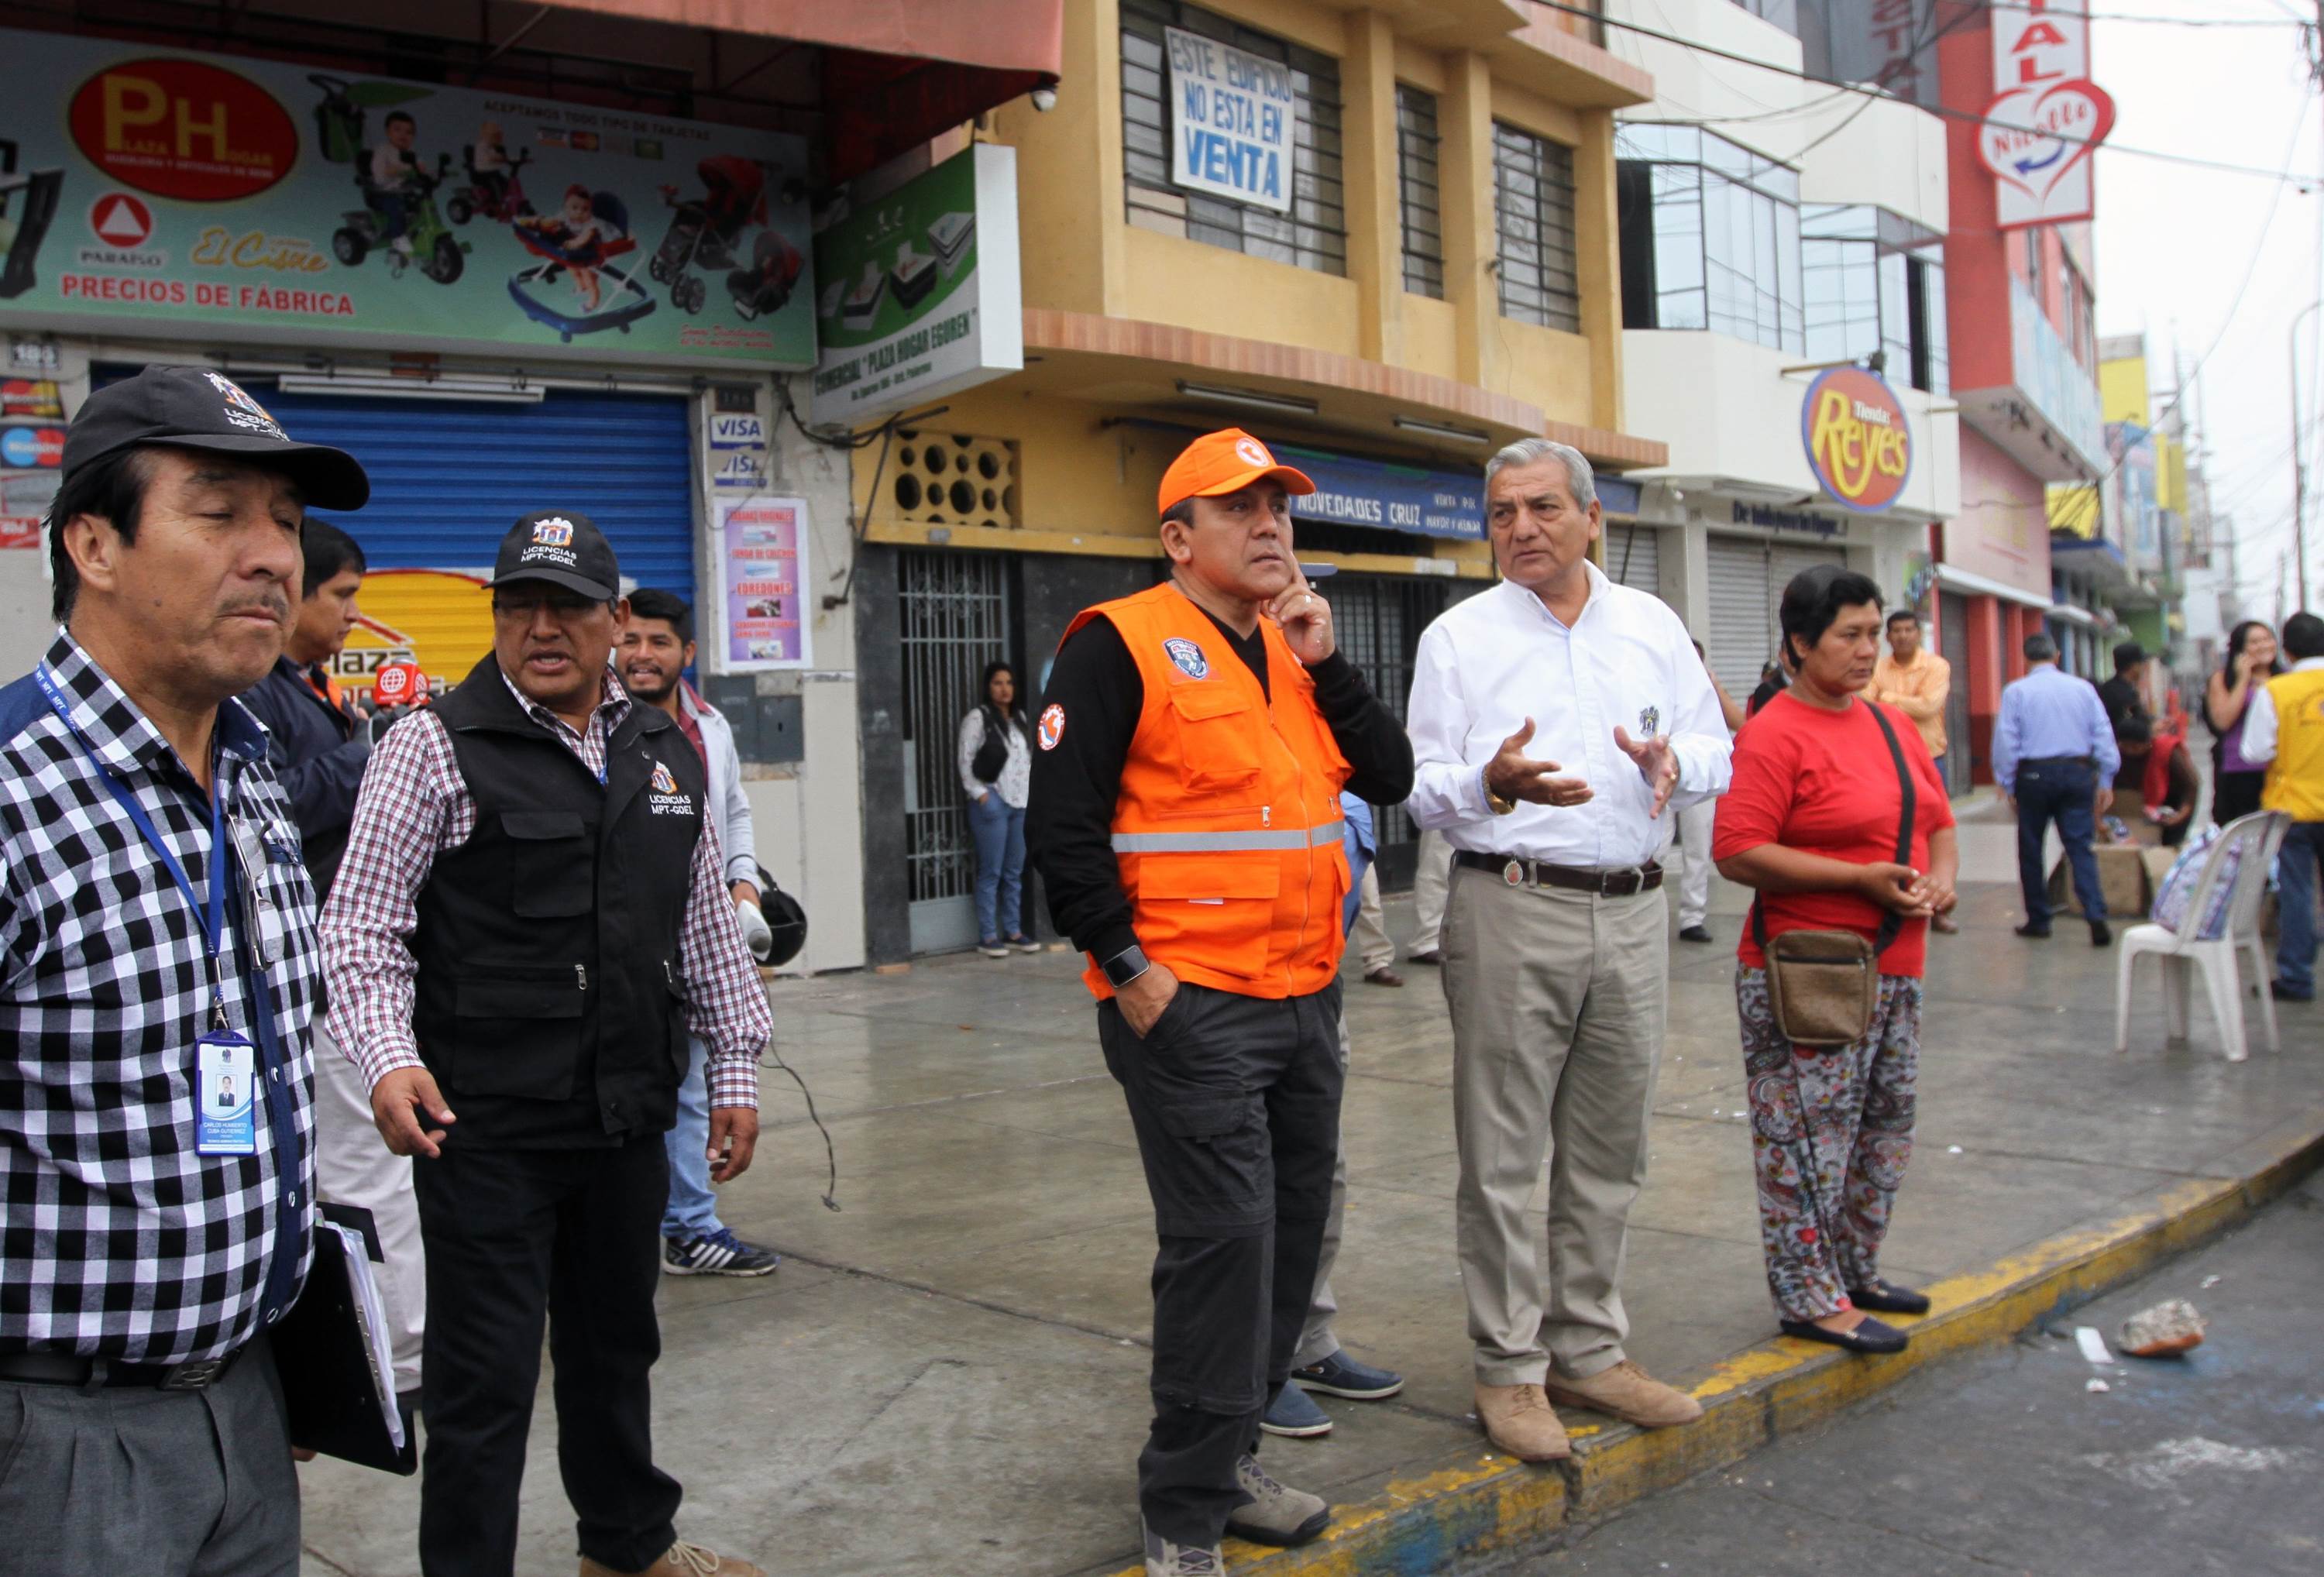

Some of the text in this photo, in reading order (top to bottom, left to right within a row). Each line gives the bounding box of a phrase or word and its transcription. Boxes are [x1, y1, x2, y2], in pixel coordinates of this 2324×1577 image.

[1169, 33, 1291, 102] ESTE EDIFICIO
[1184, 80, 1282, 145] NO ESTA EN
[1993, 101, 2087, 159] Nicolle
[1184, 125, 1281, 198] VENTA
[192, 226, 328, 273] El Cisne
[61, 275, 353, 315] PRECIOS DE FÁBRICA
[717, 419, 761, 435] VISA
[1854, 400, 1891, 425] Tiendas
[1812, 389, 1908, 499] Reyes
[1298, 492, 1421, 526] NOVEDADES CRUZ
[1425, 515, 1481, 533] MAYOR Y MENOR
[521, 552, 576, 567] MPT-GDEL
[523, 545, 577, 560] LICENCIAS
[42, 681, 53, 694] MPT
[52, 696, 67, 709] MPT
[649, 794, 691, 805] LICENCIAS
[651, 804, 694, 816] MPT-GDEL
